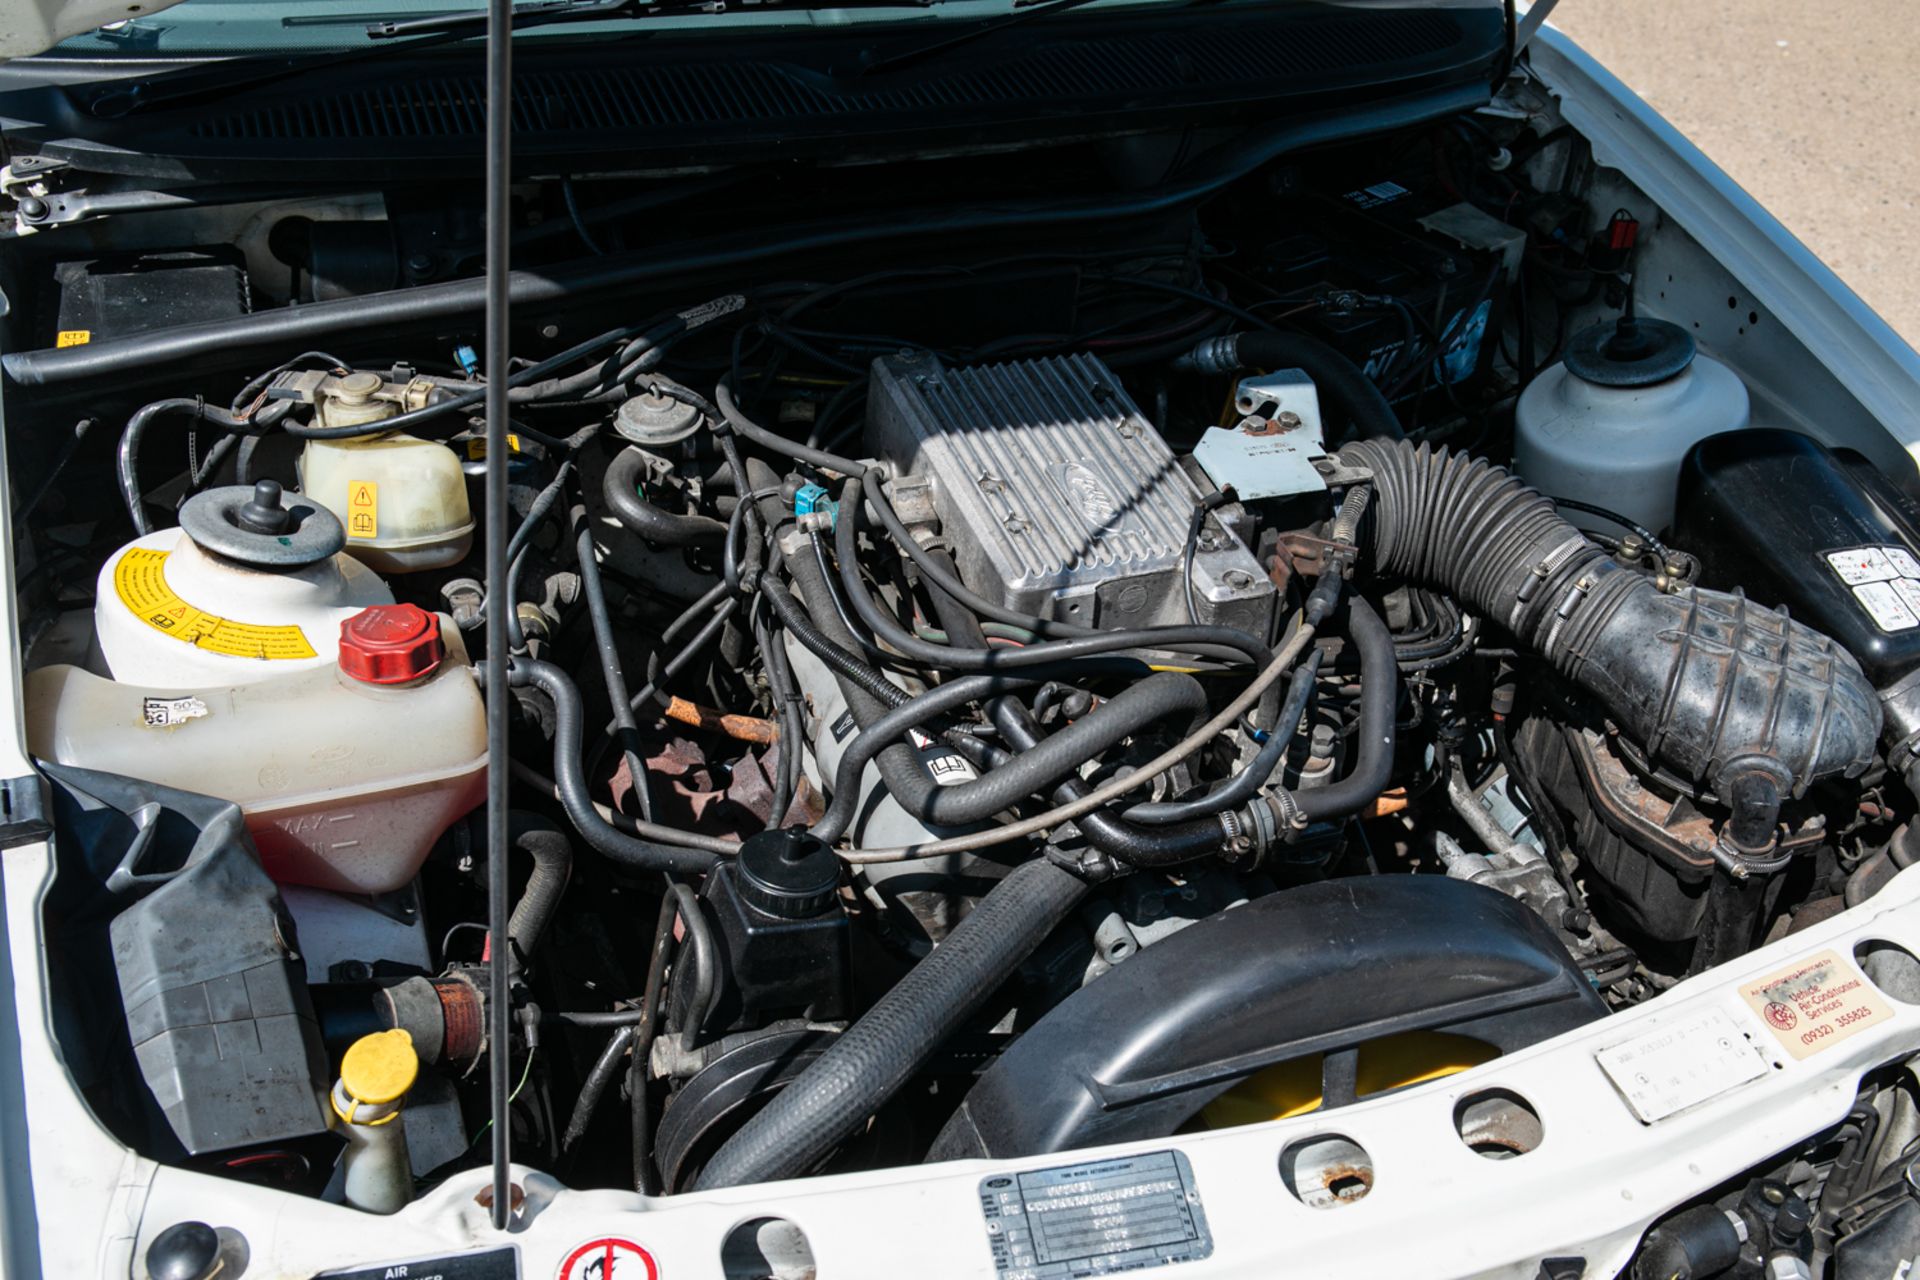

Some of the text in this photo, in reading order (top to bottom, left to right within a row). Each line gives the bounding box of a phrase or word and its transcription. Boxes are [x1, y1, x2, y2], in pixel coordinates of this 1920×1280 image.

[1788, 984, 1822, 1003] Vehicle
[1805, 999, 1844, 1021] Services
[1800, 1005, 1873, 1046] (0932) 355825
[385, 1265, 408, 1280] AIR
